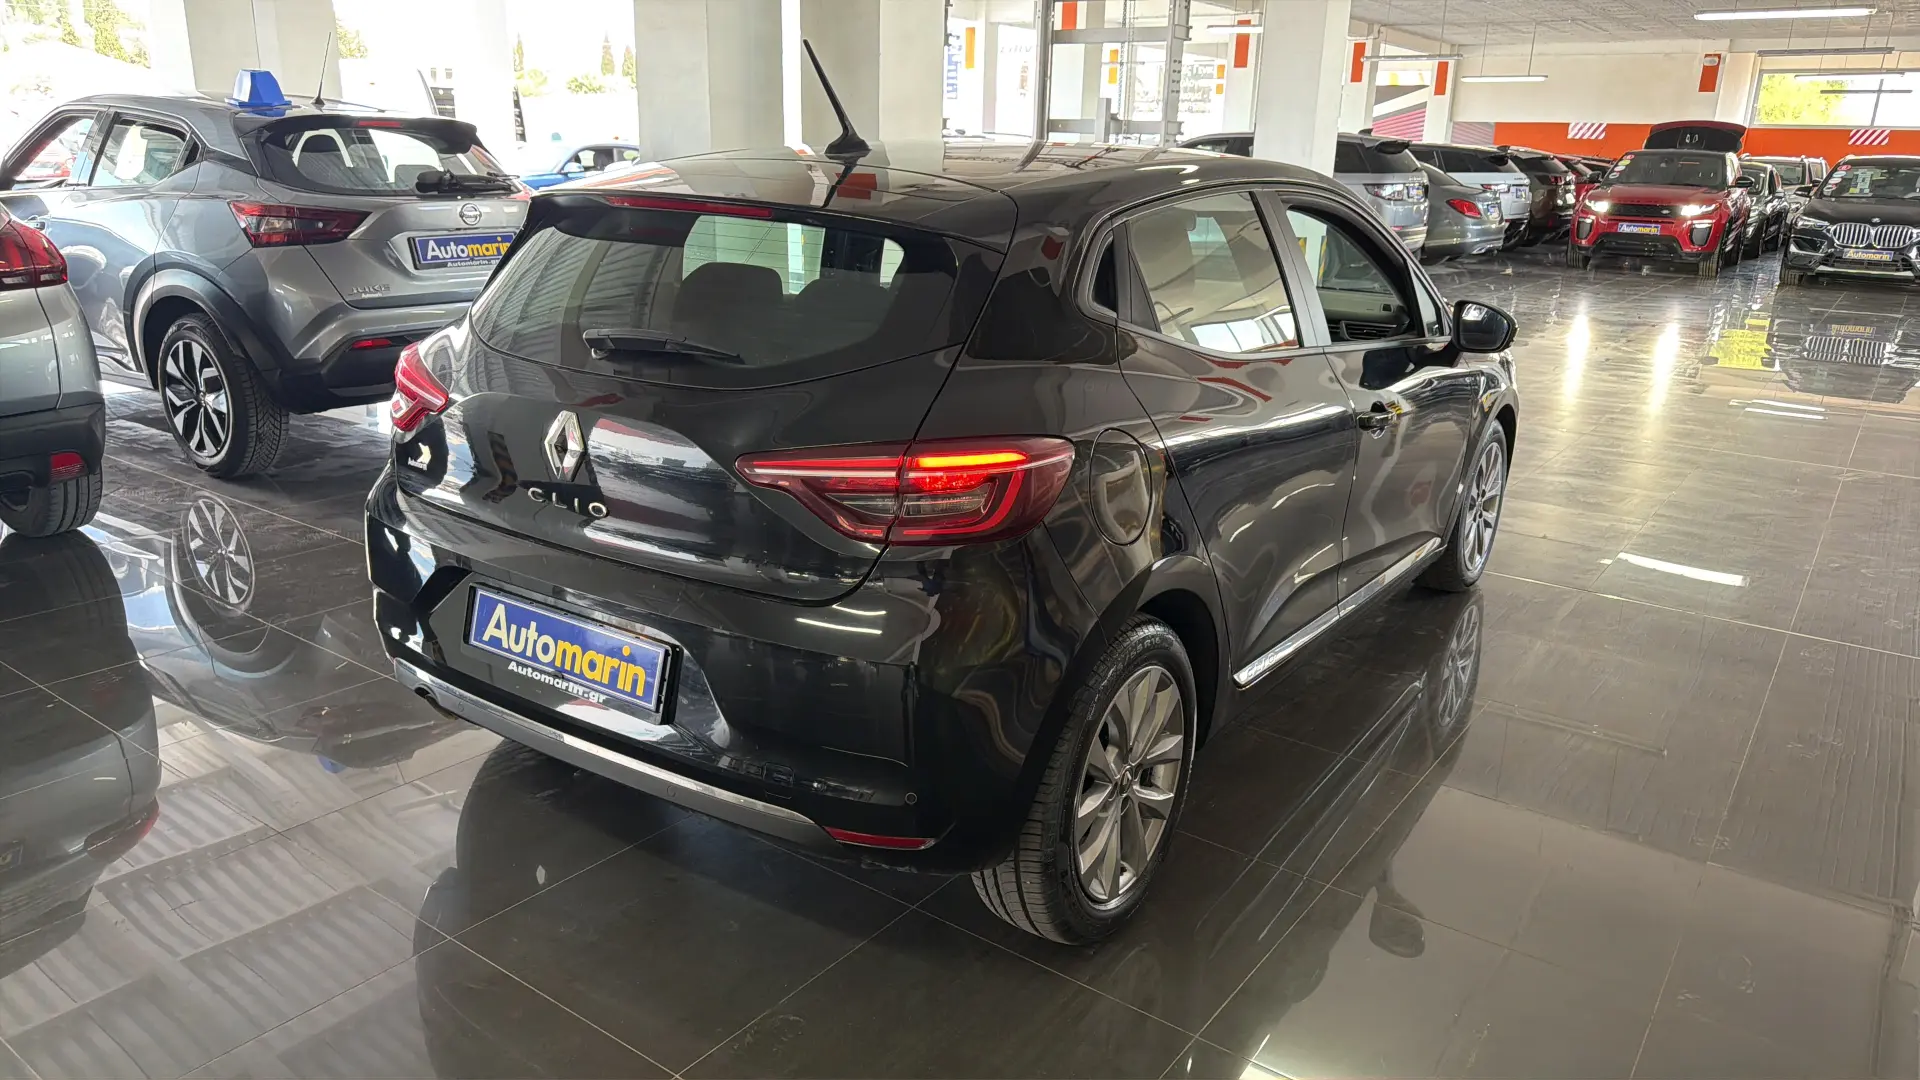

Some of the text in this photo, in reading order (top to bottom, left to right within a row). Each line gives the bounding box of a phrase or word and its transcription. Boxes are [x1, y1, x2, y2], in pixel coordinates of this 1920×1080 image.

[1620, 224, 1658, 233] Automarin
[1847, 250, 1890, 260] Automarin
[350, 283, 390, 295] JUKE
[528, 487, 607, 517] CLIO
[482, 603, 646, 697] Automarin
[507, 661, 606, 703] Automarin.gr
